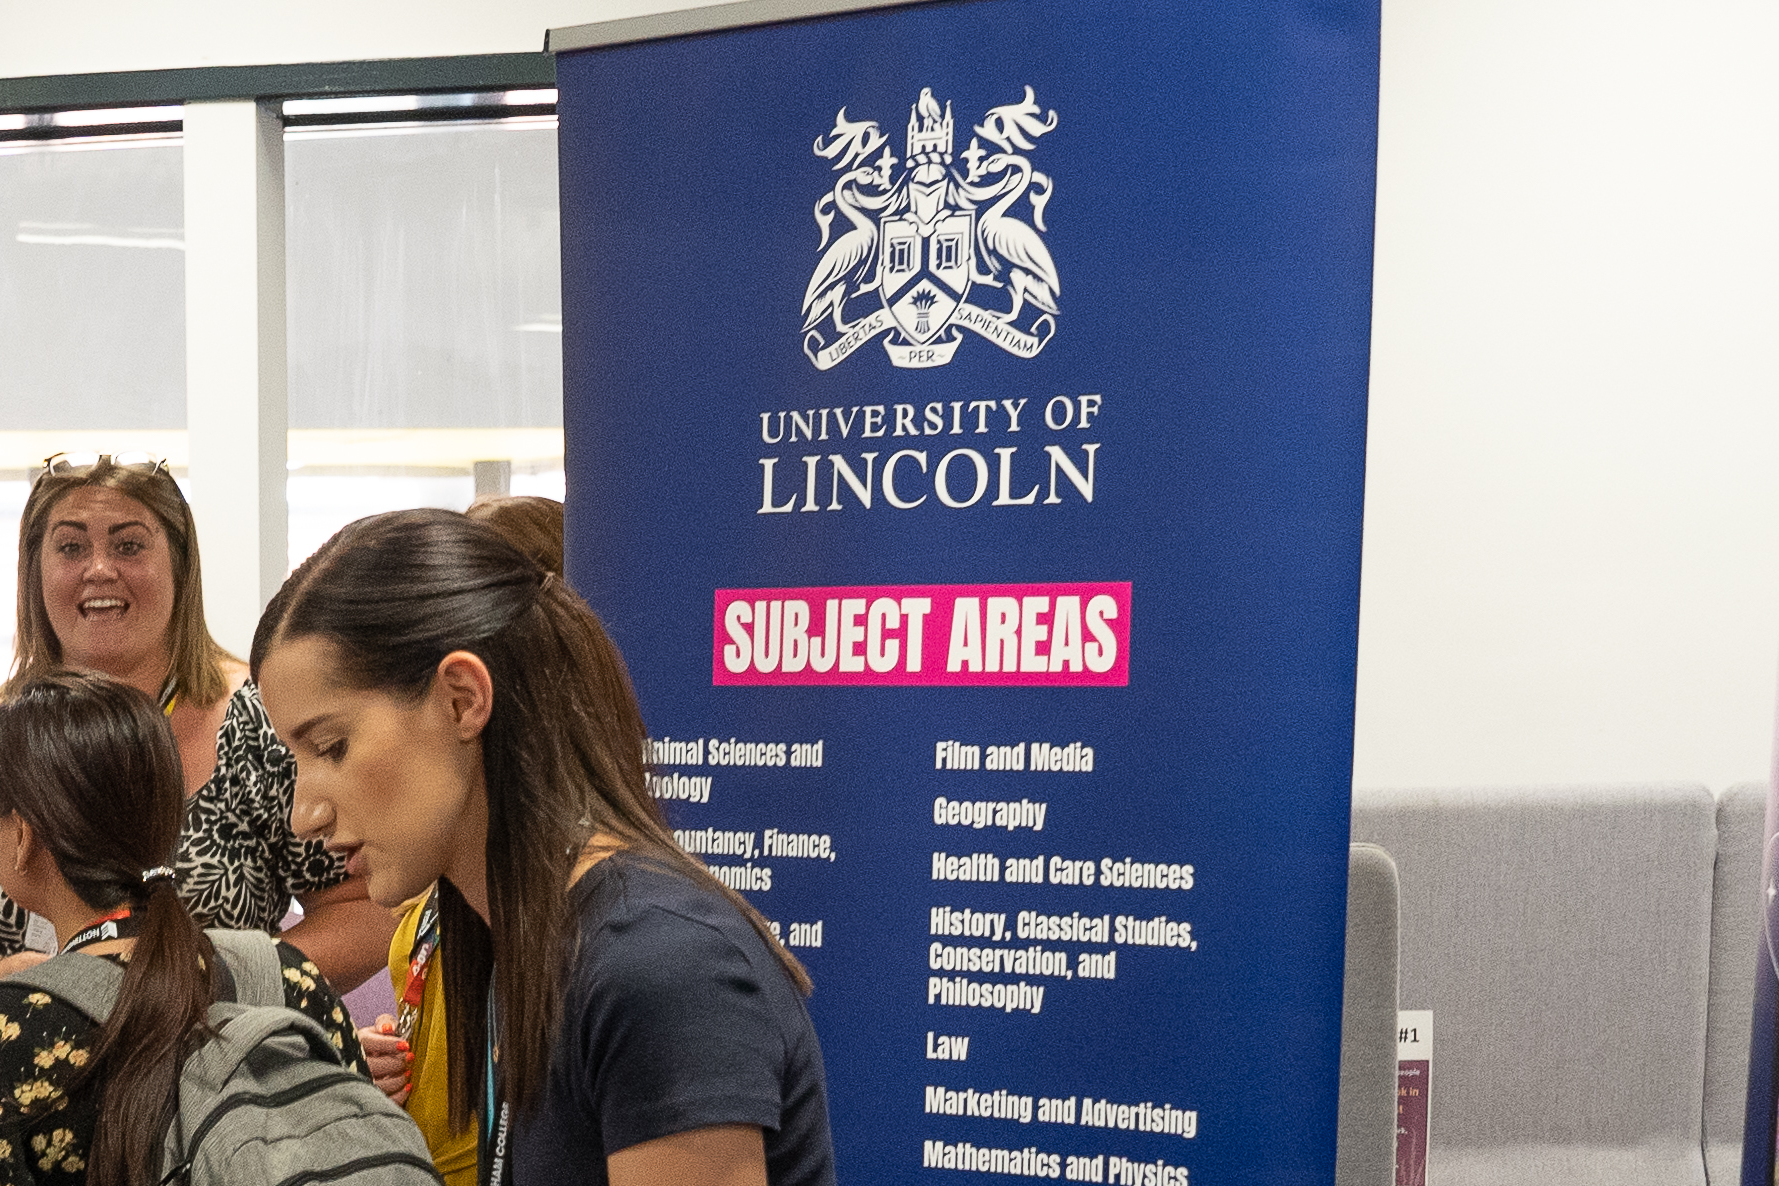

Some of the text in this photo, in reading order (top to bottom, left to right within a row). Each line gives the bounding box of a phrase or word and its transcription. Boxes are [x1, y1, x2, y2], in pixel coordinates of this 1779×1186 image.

[828, 315, 885, 363] LIBERTAS
[956, 308, 1035, 355] SAPIENTIAM
[760, 394, 1102, 444] UNIVERSITY OF
[757, 443, 1101, 514] LINCOLN
[723, 594, 1119, 674] SUBJECT AREAS
[707, 737, 787, 767] Sciences
[790, 739, 824, 768] and
[935, 740, 1094, 772] Film and Media
[933, 796, 1047, 831] Geography
[763, 828, 836, 862] Finance,
[931, 851, 1195, 890] Health and Care Sciences
[788, 920, 823, 948] and
[930, 906, 1198, 952] History, Classical Studies,
[929, 941, 1117, 980] Conservation, and
[927, 976, 1045, 1014] Philosophy
[926, 1031, 970, 1061] Law
[924, 1085, 1198, 1139] Marketing and Advertising
[923, 1139, 1061, 1179] Mathematics
[1065, 1154, 1104, 1183] and
